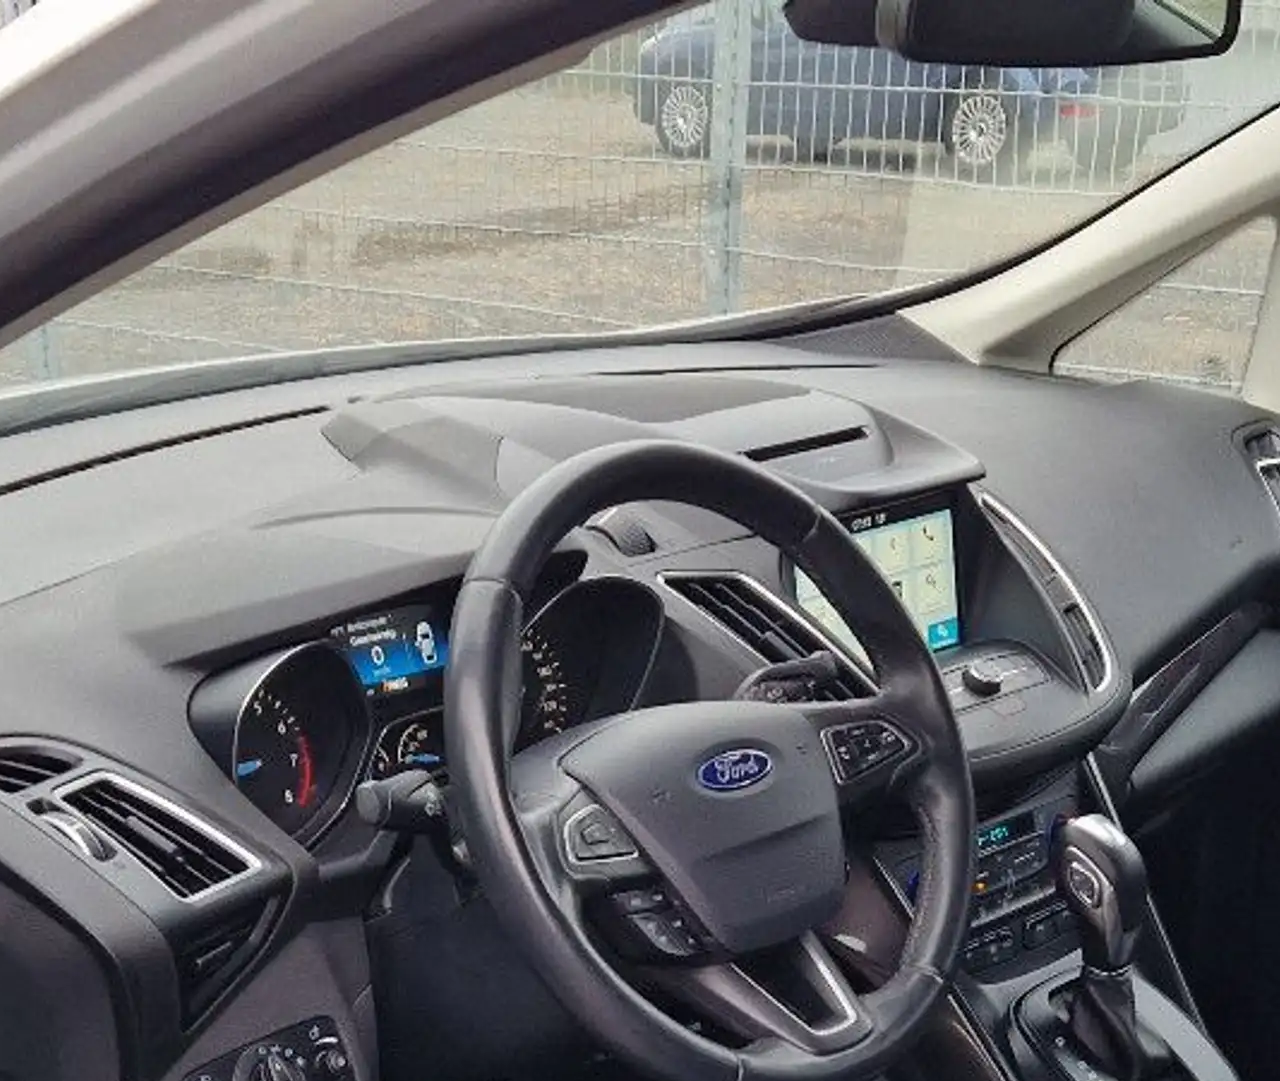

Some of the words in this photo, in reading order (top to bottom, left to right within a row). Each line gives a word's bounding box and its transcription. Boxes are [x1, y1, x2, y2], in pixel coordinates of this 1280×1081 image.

[371, 645, 385, 666] 0
[253, 701, 263, 716] 5
[277, 720, 287, 735] 6
[714, 752, 760, 783] Ford
